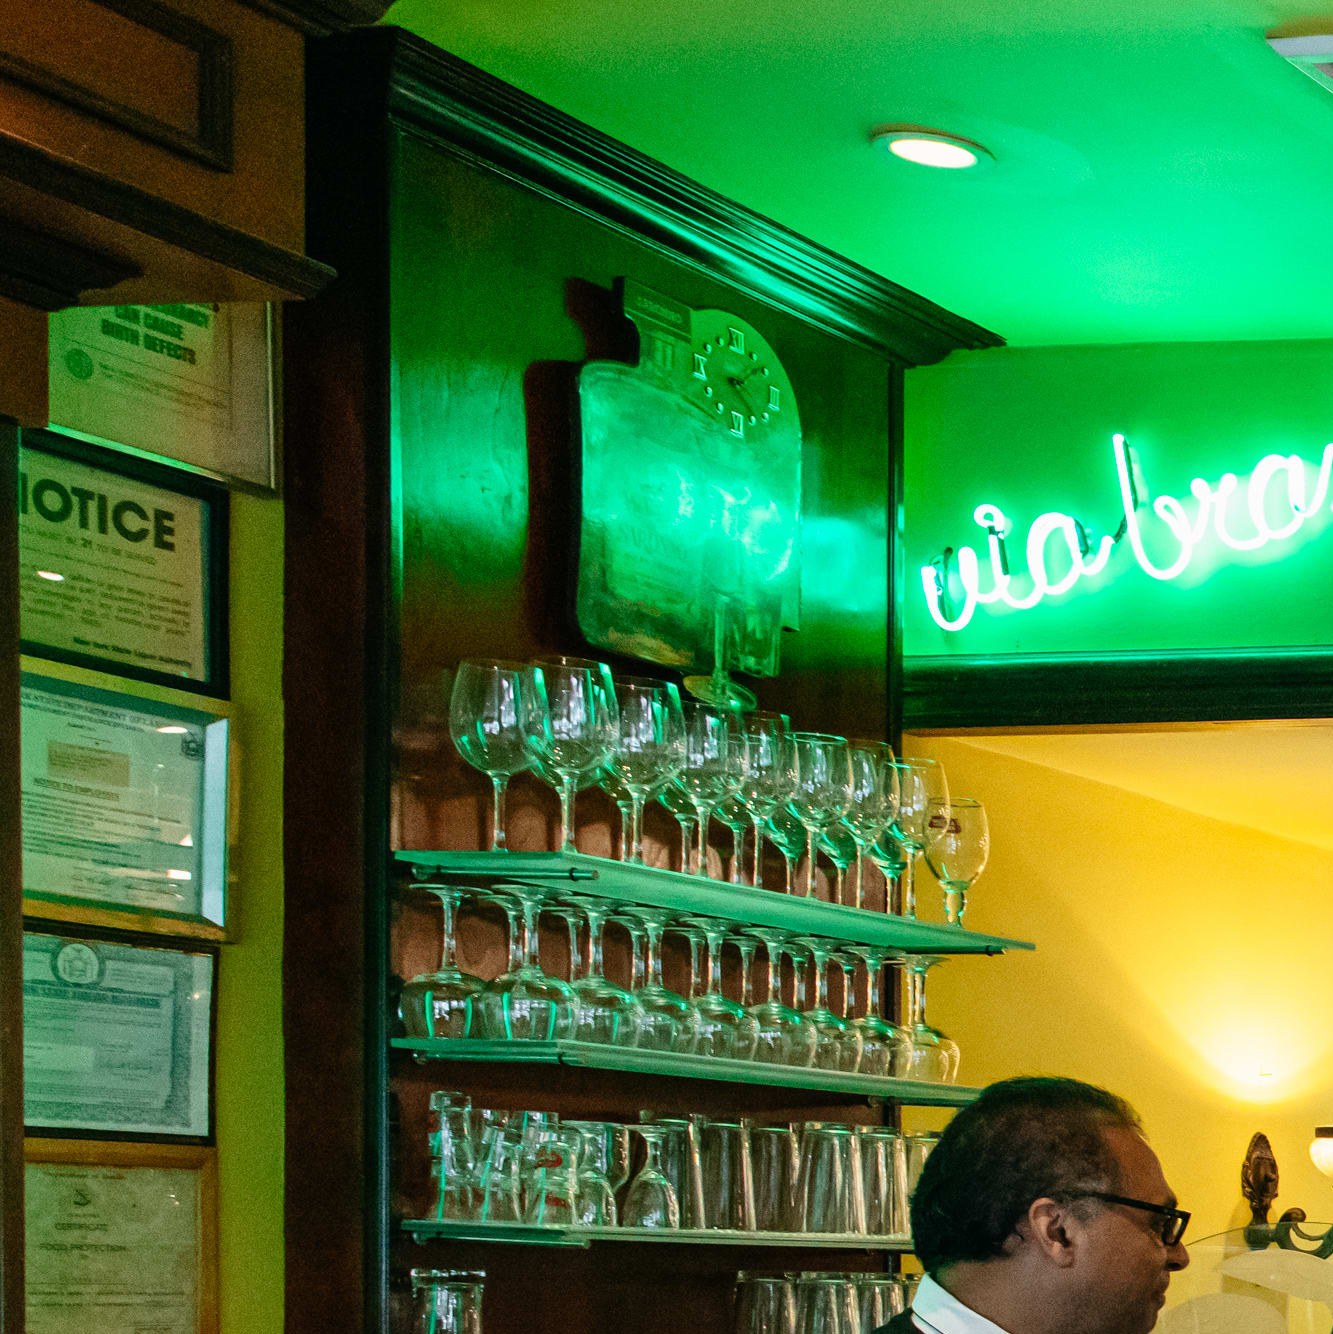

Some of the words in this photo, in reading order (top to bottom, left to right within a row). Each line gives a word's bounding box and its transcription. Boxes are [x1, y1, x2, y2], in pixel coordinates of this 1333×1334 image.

[143, 333, 196, 365] DEFECTS
[21, 472, 175, 552] OTICE
[921, 503, 1115, 631] via
